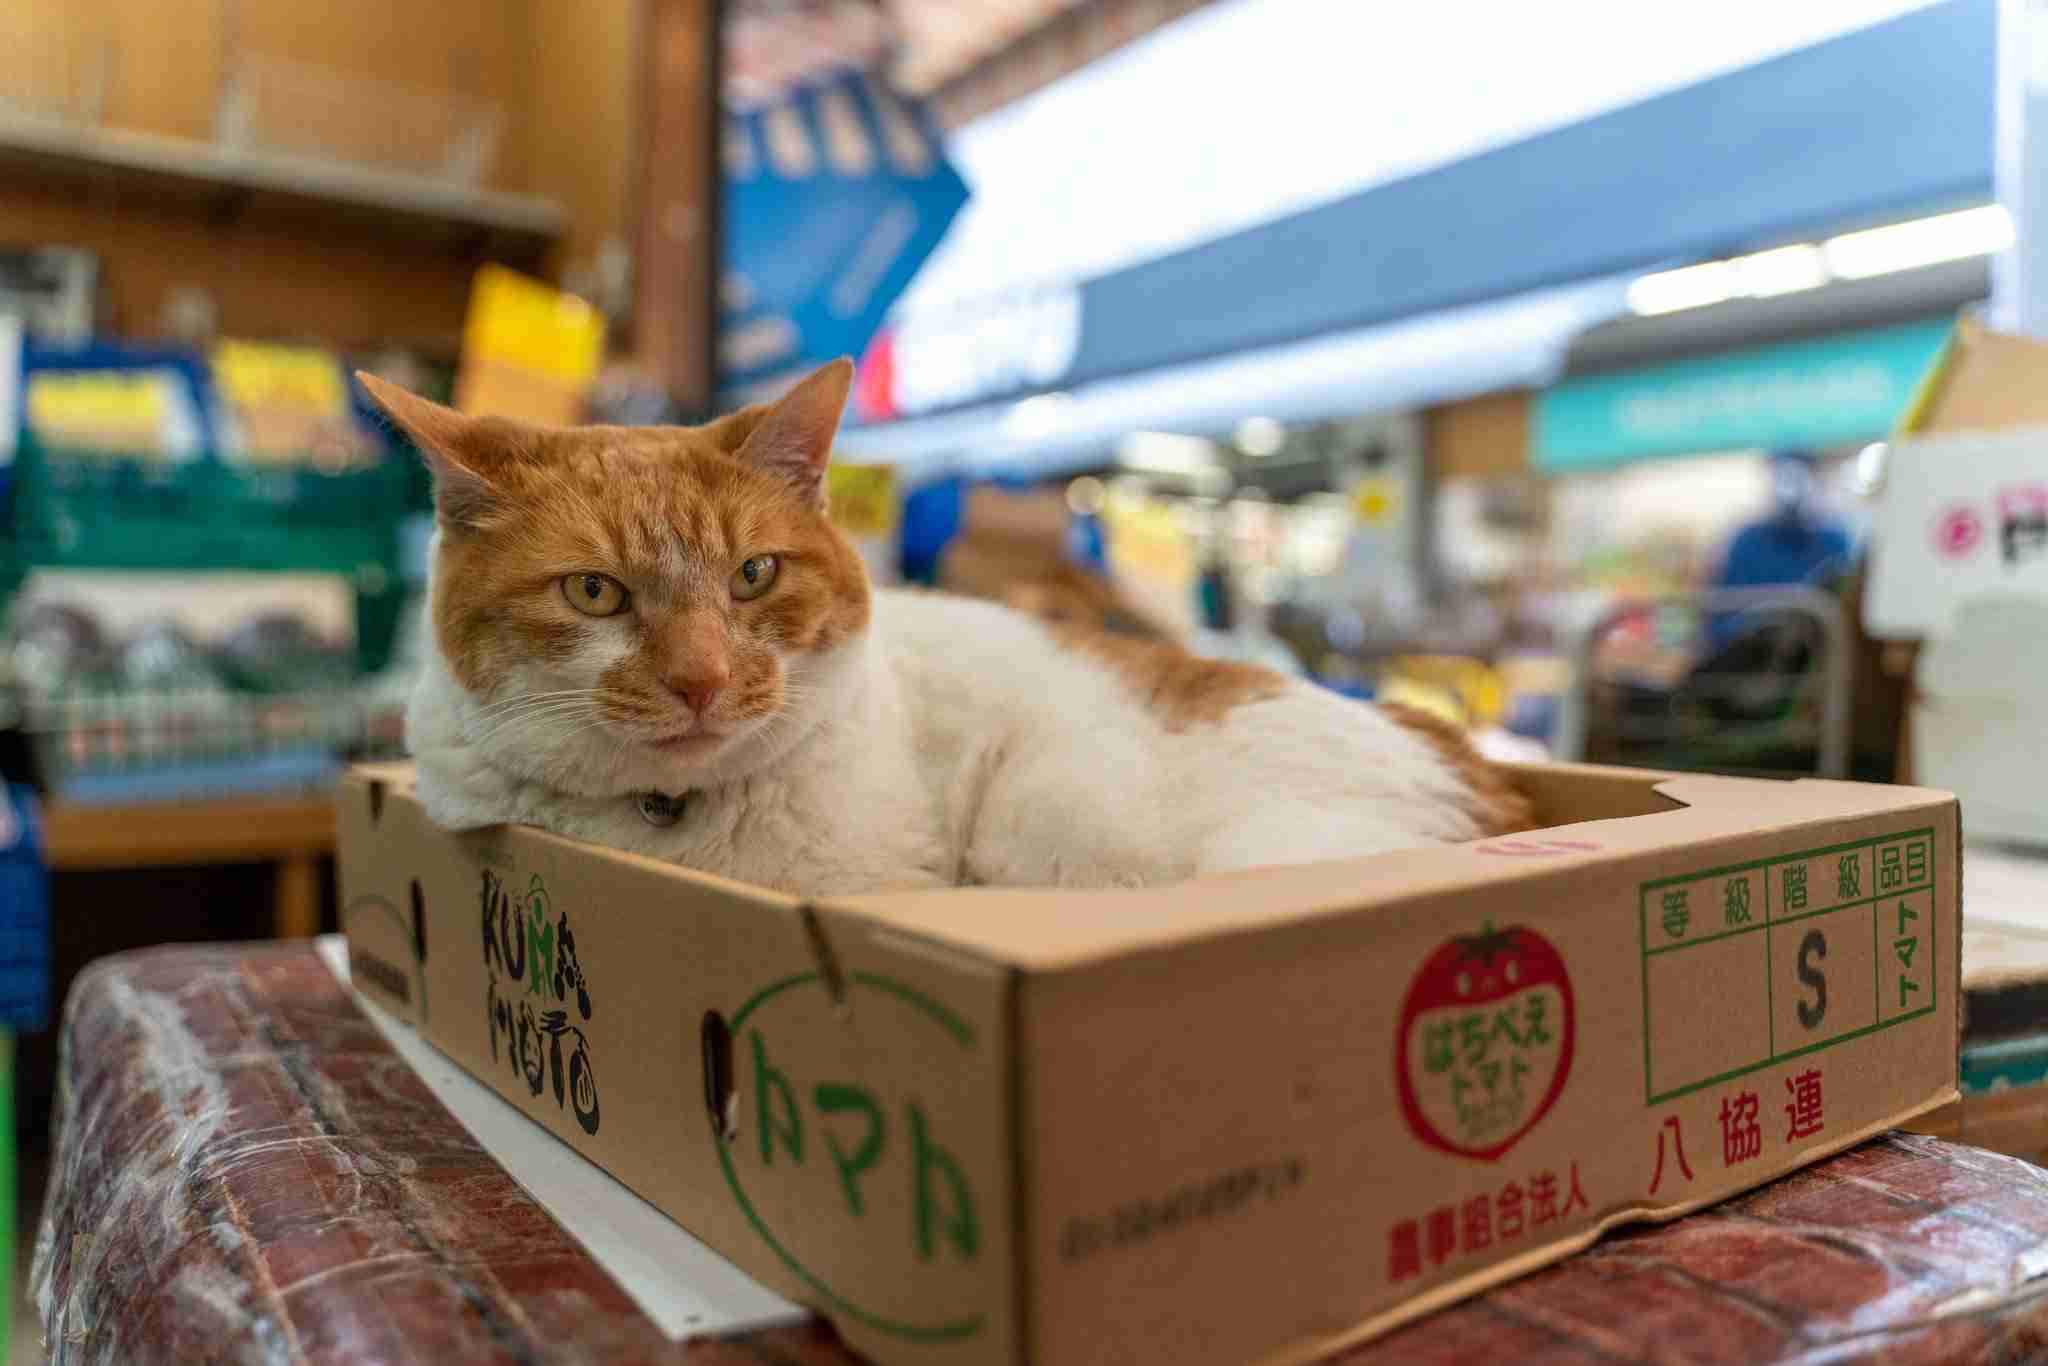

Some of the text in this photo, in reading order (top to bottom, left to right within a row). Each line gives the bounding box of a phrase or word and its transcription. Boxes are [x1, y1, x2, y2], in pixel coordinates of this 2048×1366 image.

[1880, 841, 1927, 889] 品目
[1796, 928, 1827, 1031] S
[1892, 899, 1920, 1008] トマト
